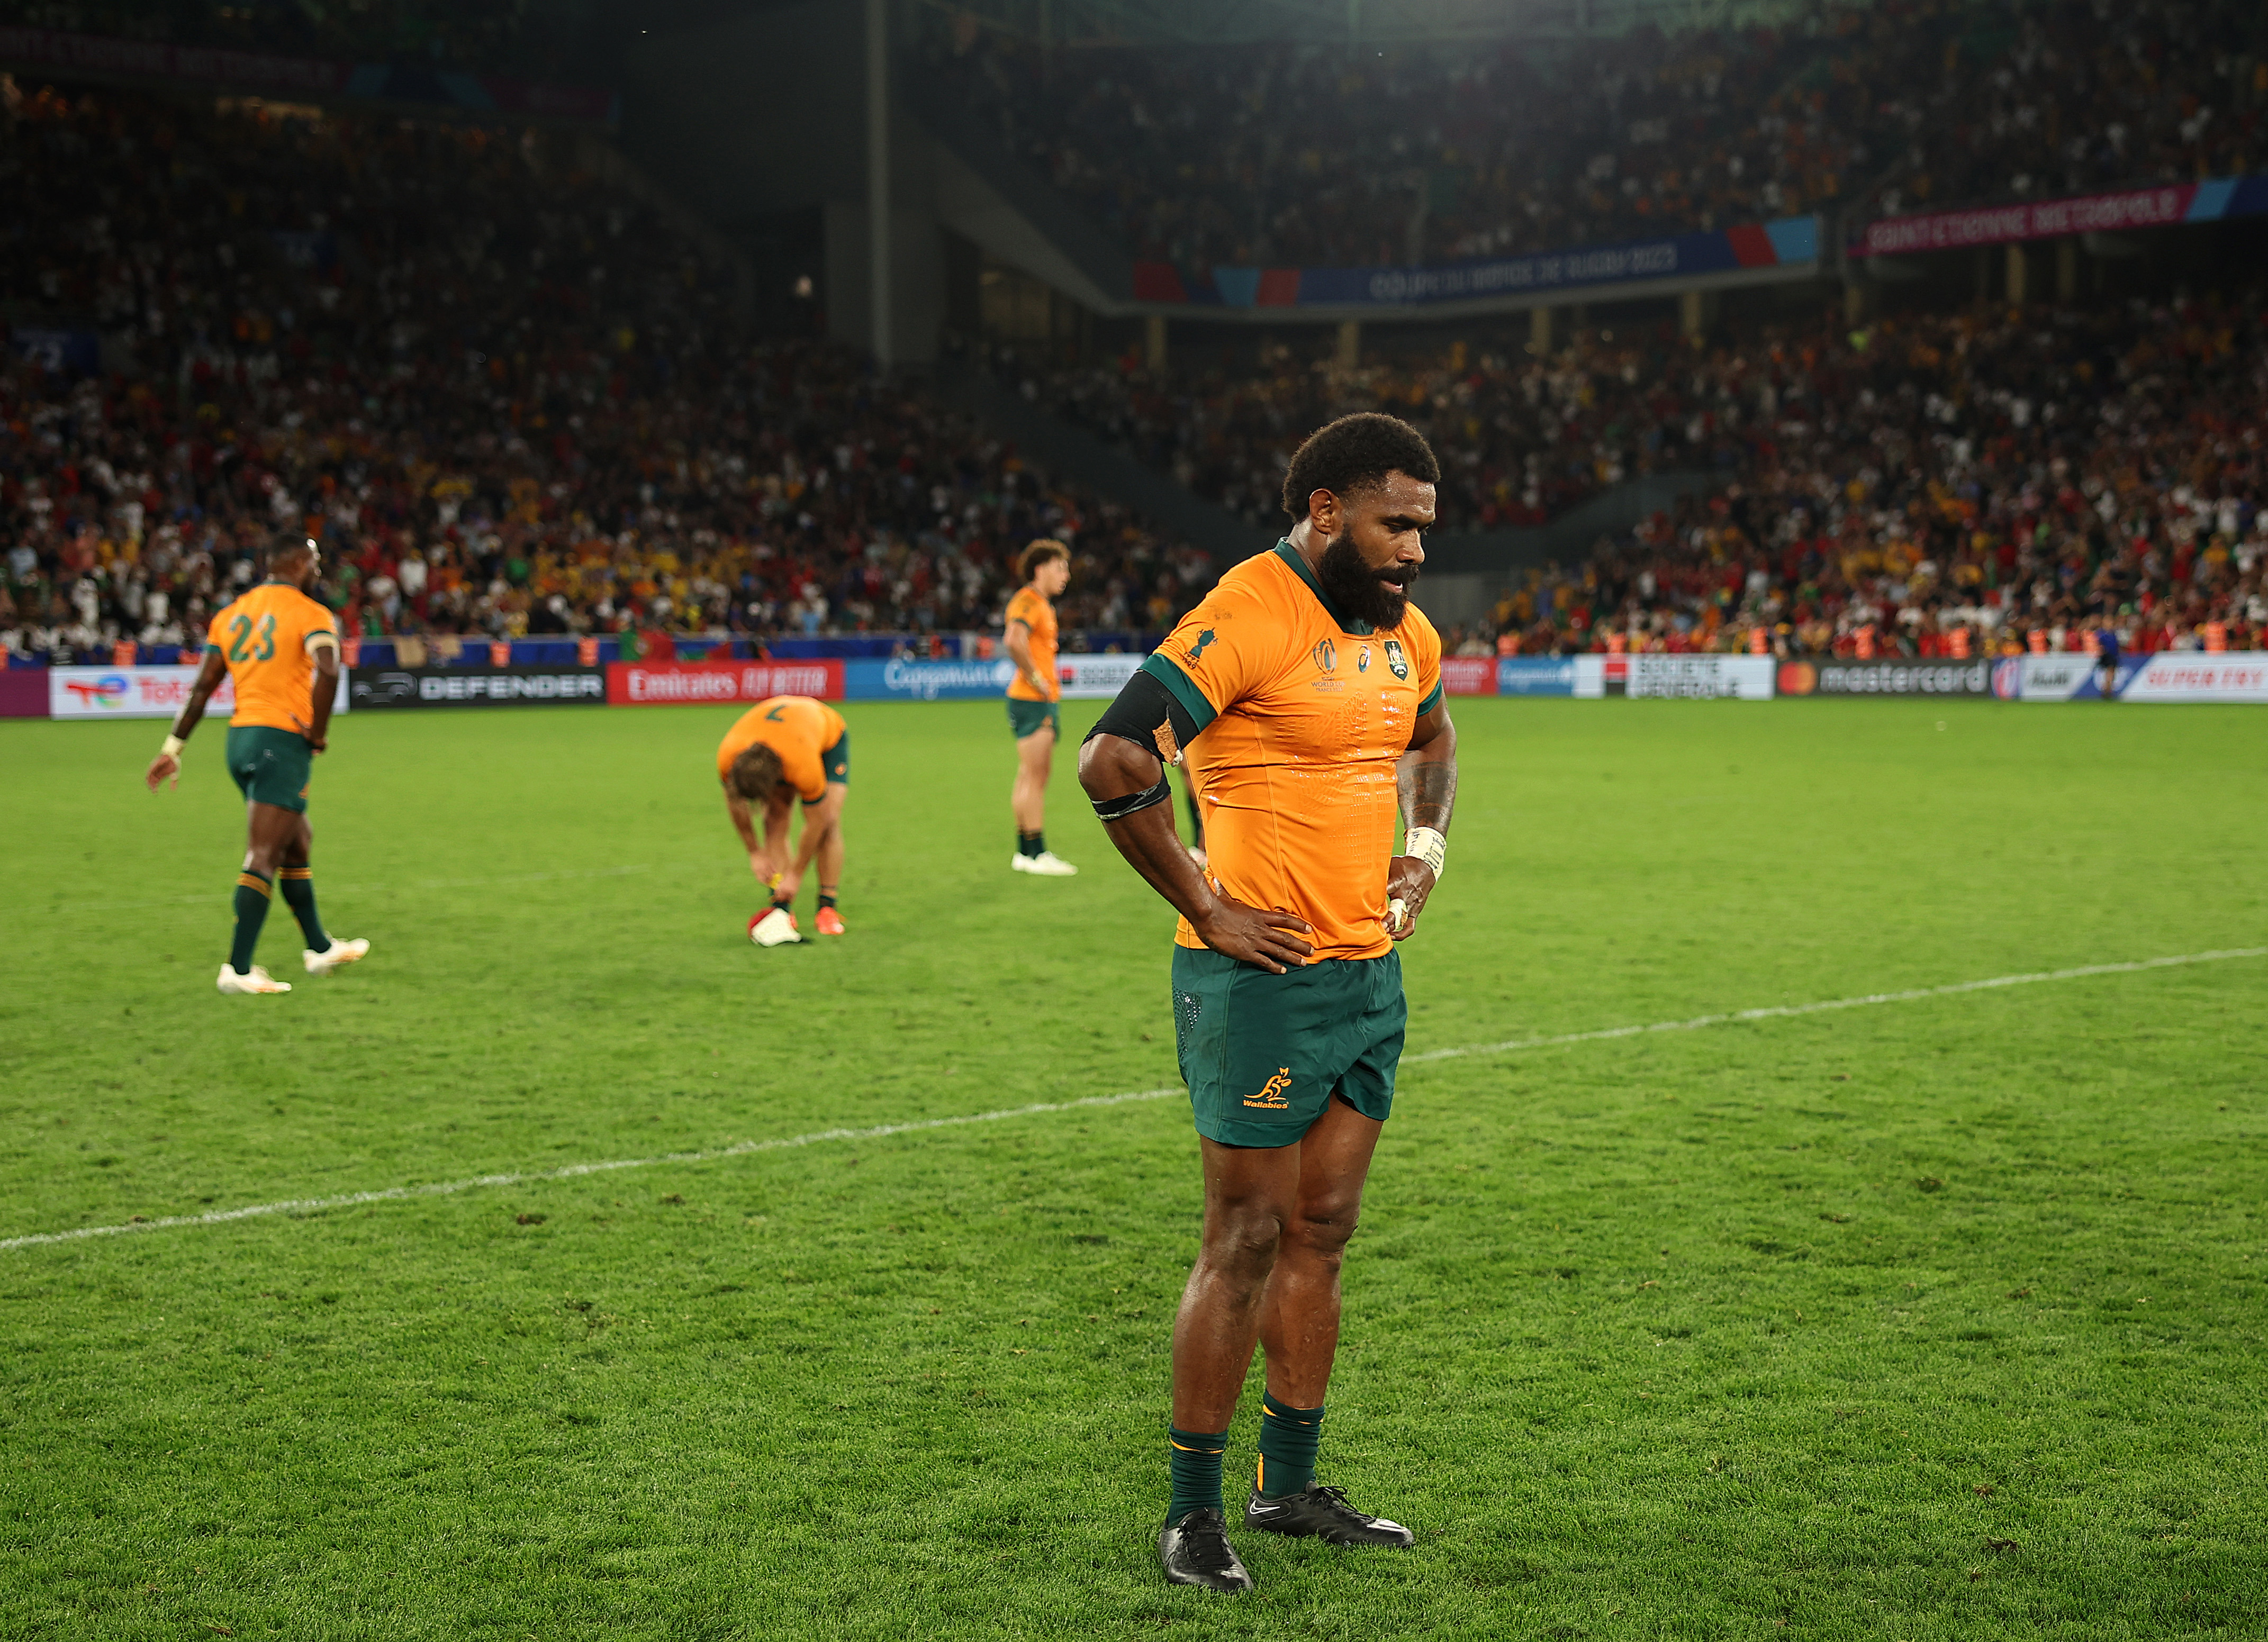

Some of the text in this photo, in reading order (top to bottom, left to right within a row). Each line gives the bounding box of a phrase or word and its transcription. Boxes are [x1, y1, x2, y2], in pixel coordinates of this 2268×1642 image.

[229, 614, 275, 660] 23
[1182, 656, 1196, 669] 1999
[1184, 652, 1199, 664] 1991
[419, 675, 604, 700] DEFENDER
[627, 668, 738, 701] Emirates
[1820, 658, 1989, 693] mastercard
[1243, 1100, 1288, 1109] Wallabies
